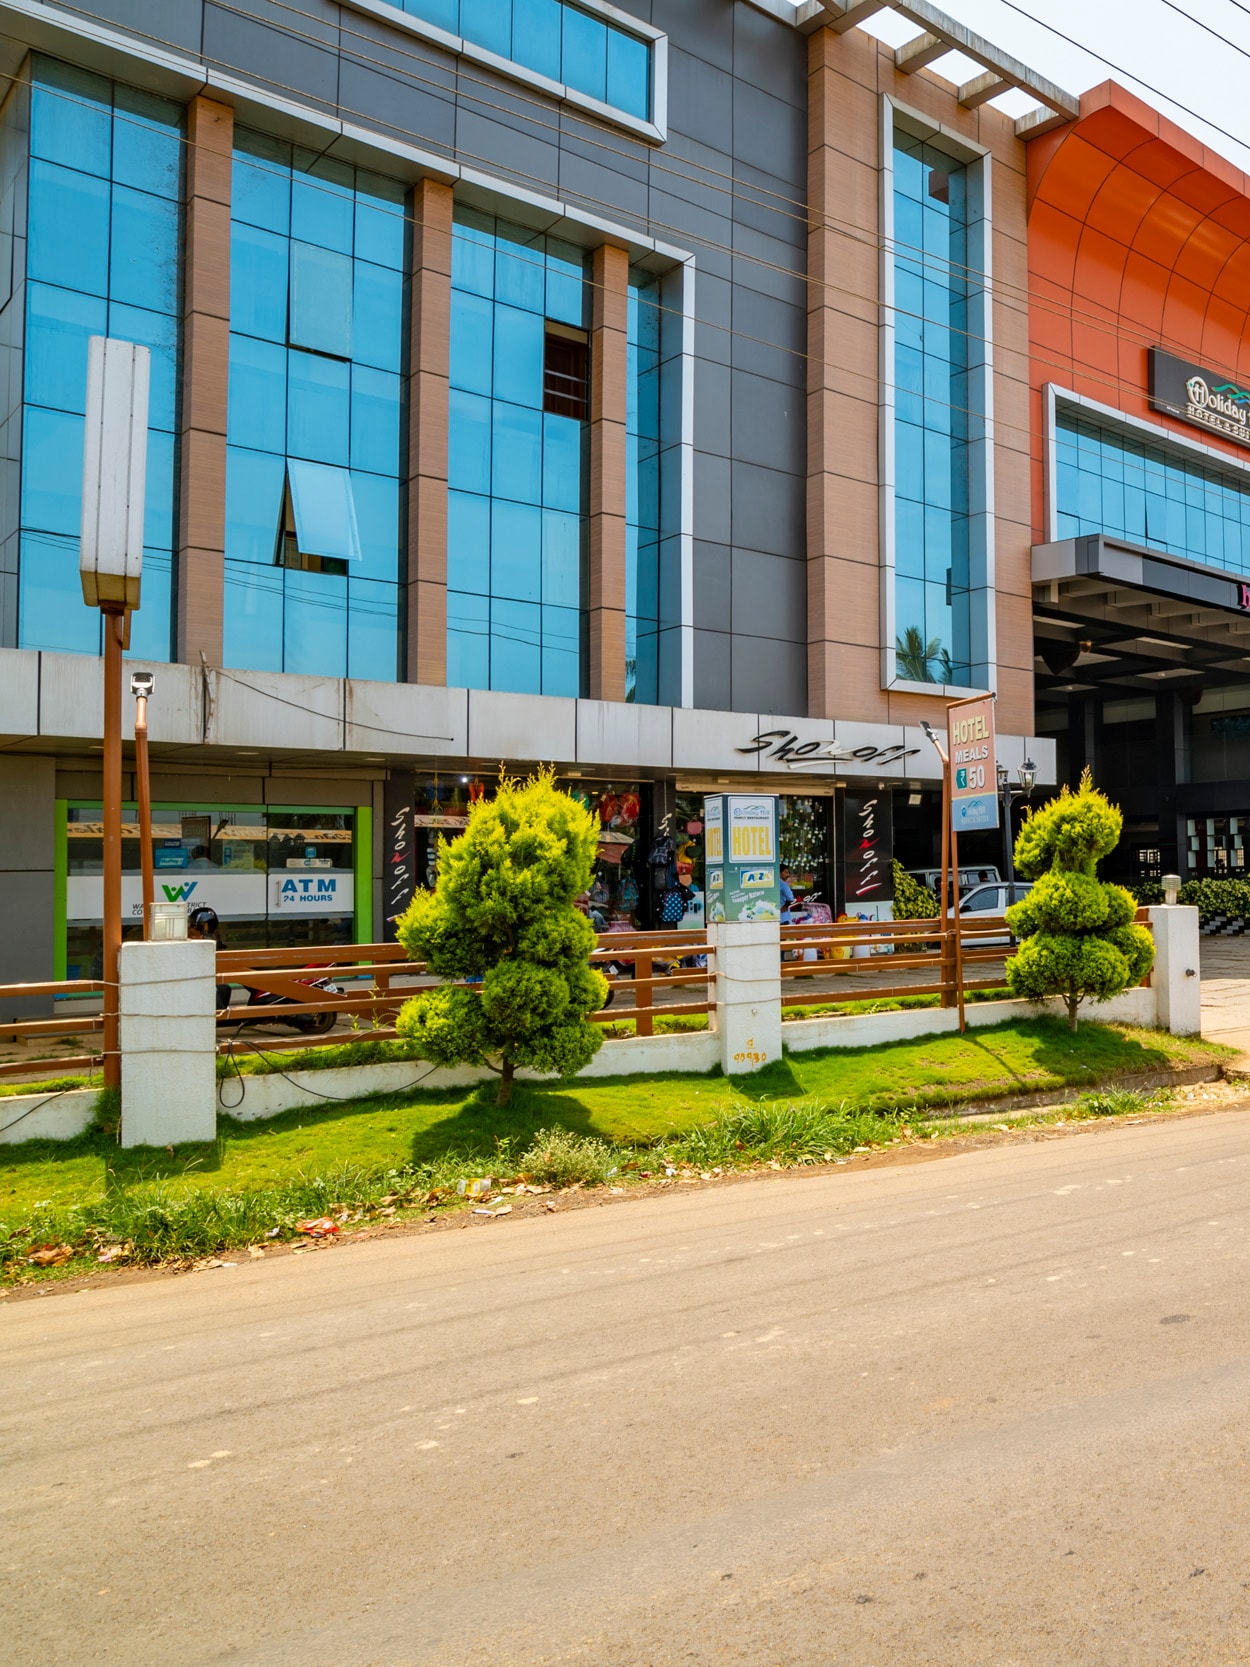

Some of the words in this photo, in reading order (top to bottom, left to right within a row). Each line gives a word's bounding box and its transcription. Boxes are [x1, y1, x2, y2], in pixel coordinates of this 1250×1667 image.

[1187, 376, 1247, 425] Holiday
[1187, 405, 1223, 428] HOTEL
[952, 715, 990, 746] HOTEL
[955, 745, 989, 765] MEALS
[969, 765, 986, 789] 50
[732, 826, 772, 856] HOTEL
[281, 878, 337, 893] ATM
[300, 894, 333, 902] HOURS
